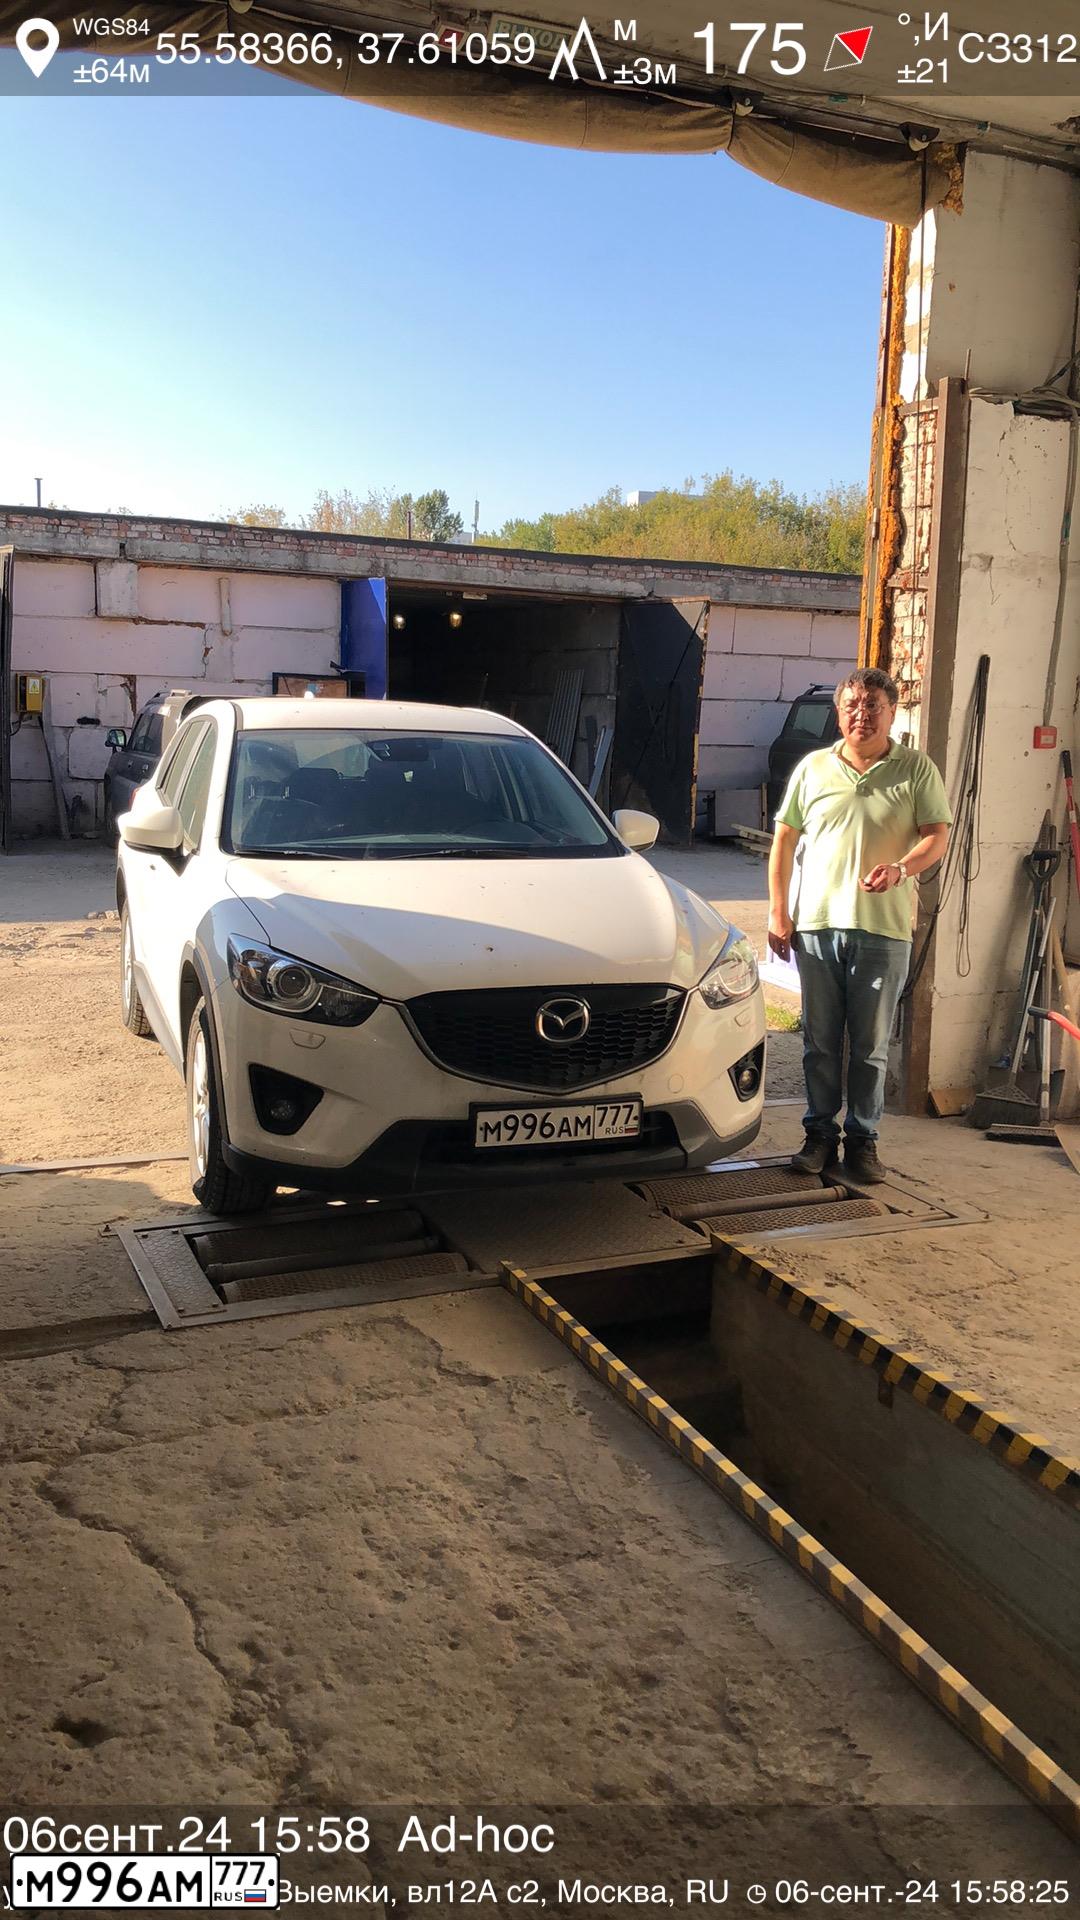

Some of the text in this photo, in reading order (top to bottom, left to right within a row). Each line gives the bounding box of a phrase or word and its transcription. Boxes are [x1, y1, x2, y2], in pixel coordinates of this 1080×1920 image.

[483, 1112, 592, 1142] М996АМ
[597, 1104, 634, 1127] 777
[605, 1127, 624, 1135] RUS
